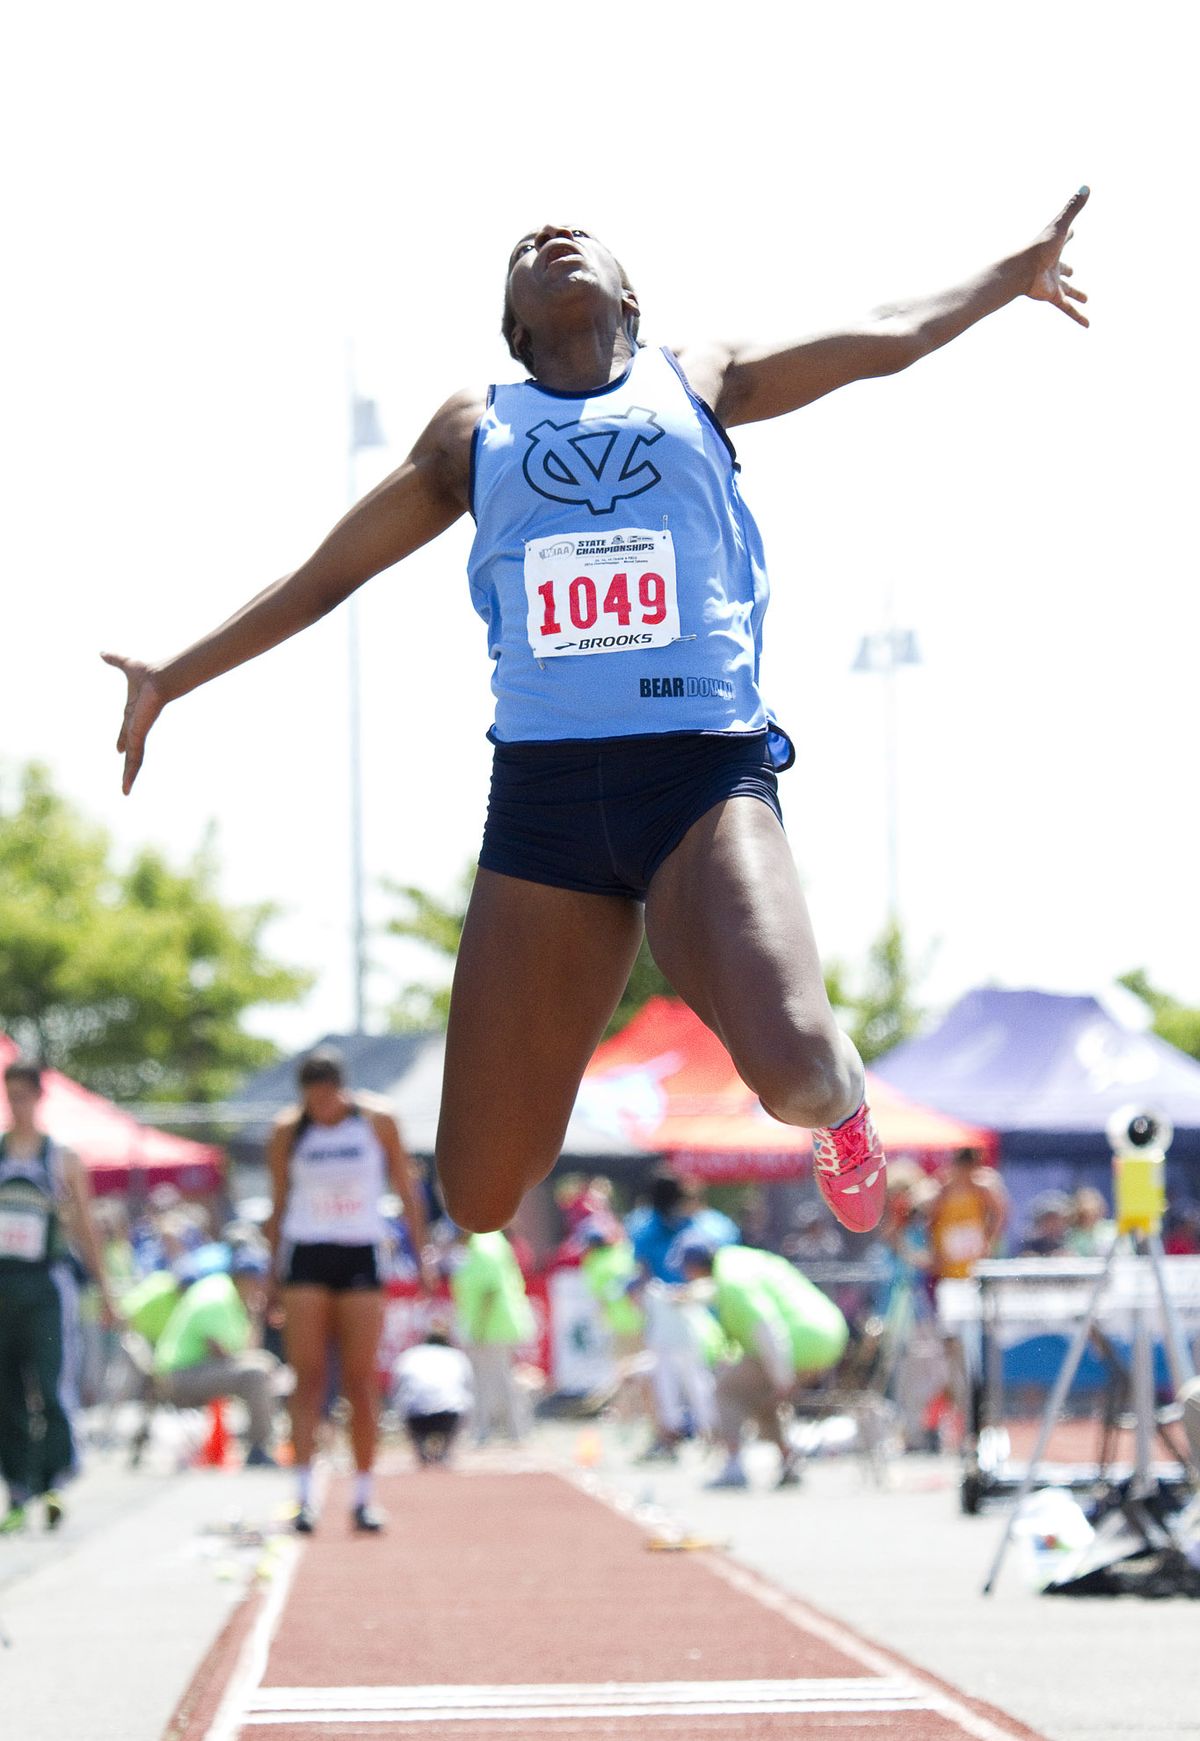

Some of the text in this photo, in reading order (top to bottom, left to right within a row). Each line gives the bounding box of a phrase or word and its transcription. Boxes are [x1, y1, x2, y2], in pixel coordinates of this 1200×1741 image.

[576, 543, 655, 556] CHAMPIONSHIPS
[578, 539, 606, 548] STATE
[538, 572, 667, 636] 1049
[578, 633, 653, 650] BROOKS
[640, 677, 684, 698] BEAR
